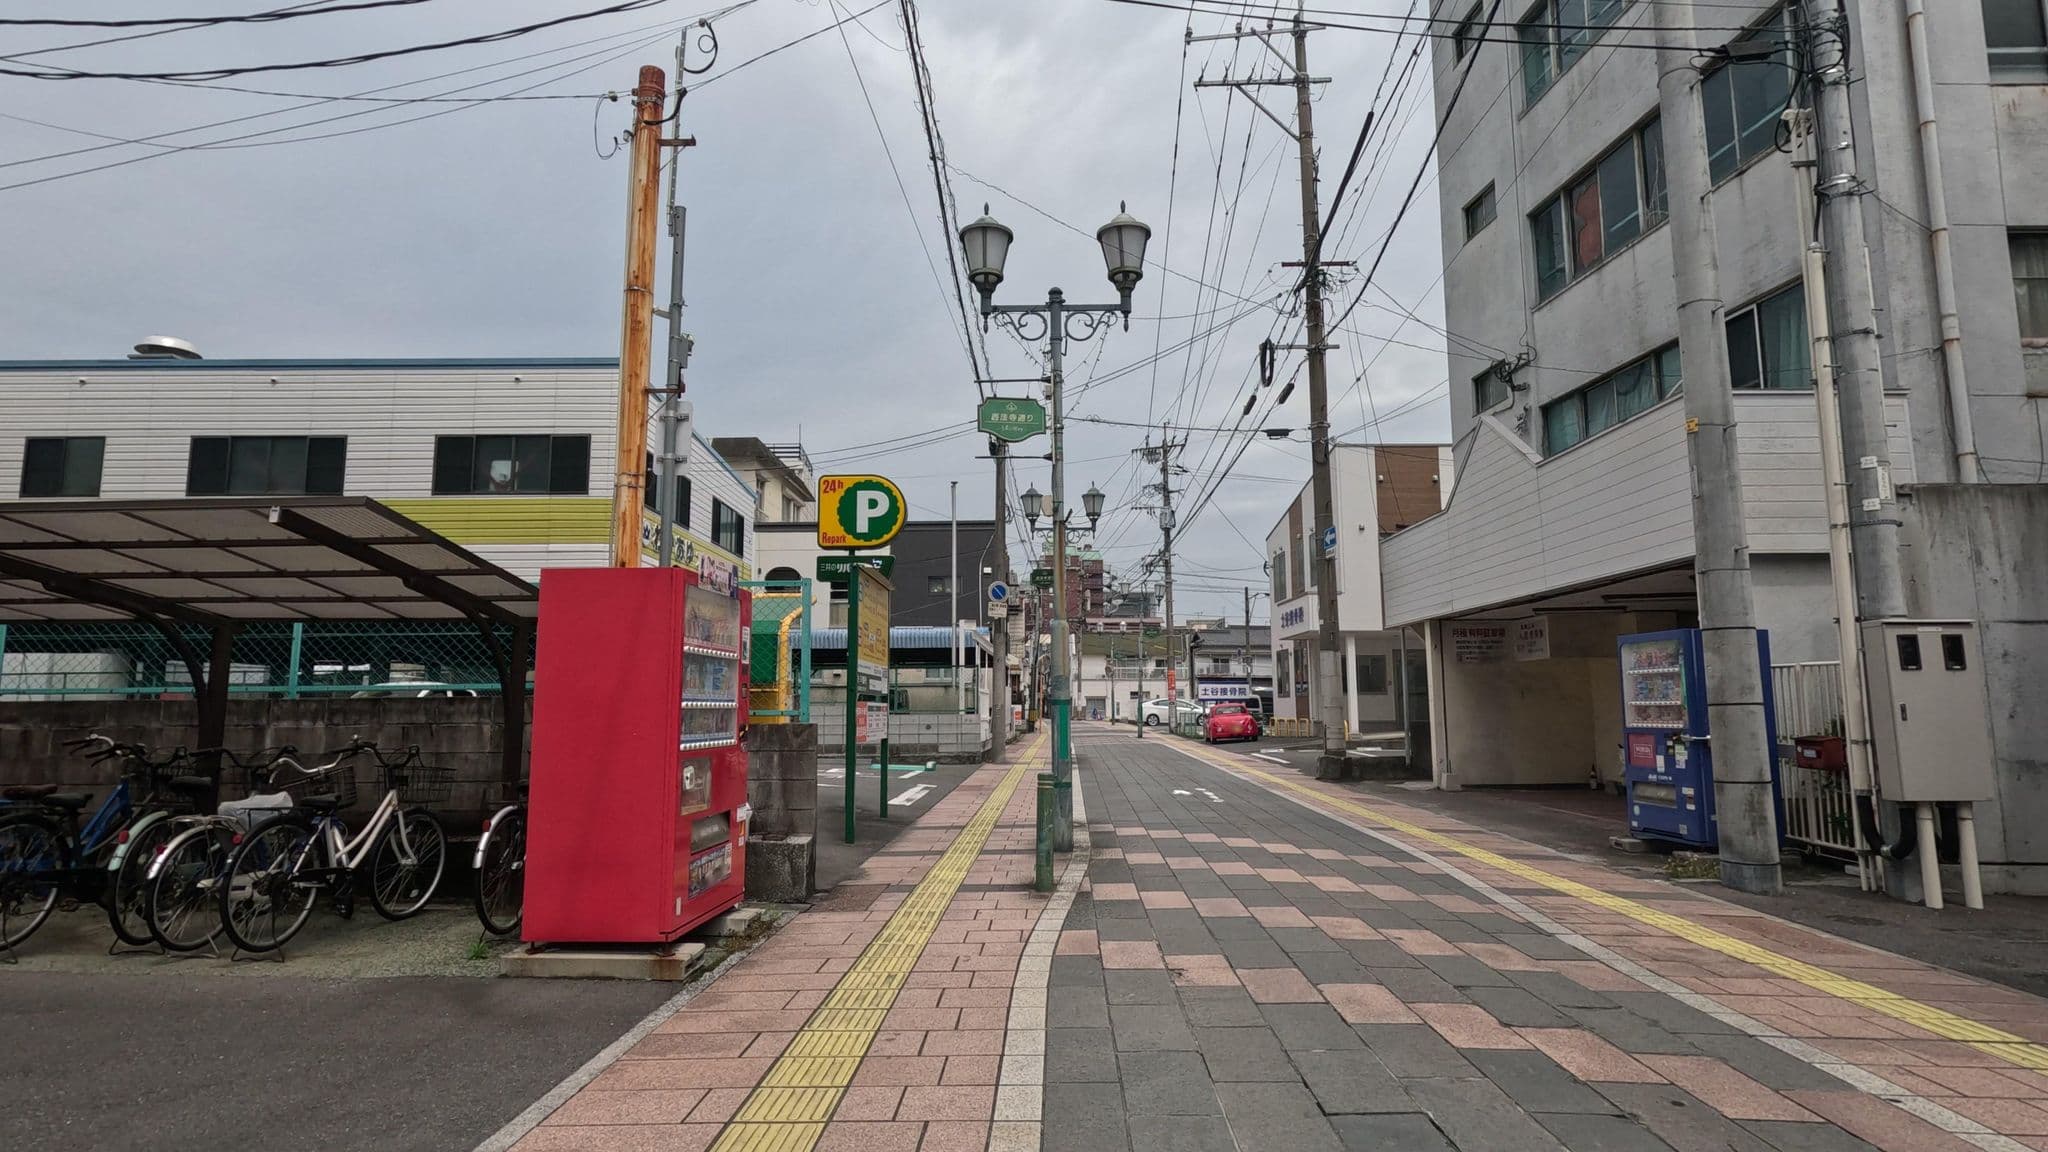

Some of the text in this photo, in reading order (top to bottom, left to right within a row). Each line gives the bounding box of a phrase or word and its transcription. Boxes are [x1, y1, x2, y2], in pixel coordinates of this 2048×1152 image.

[822, 479, 844, 494] 24h
[856, 490, 890, 533] P
[822, 532, 847, 544] Repark
[1201, 687, 1247, 697] 土谷接骨院
